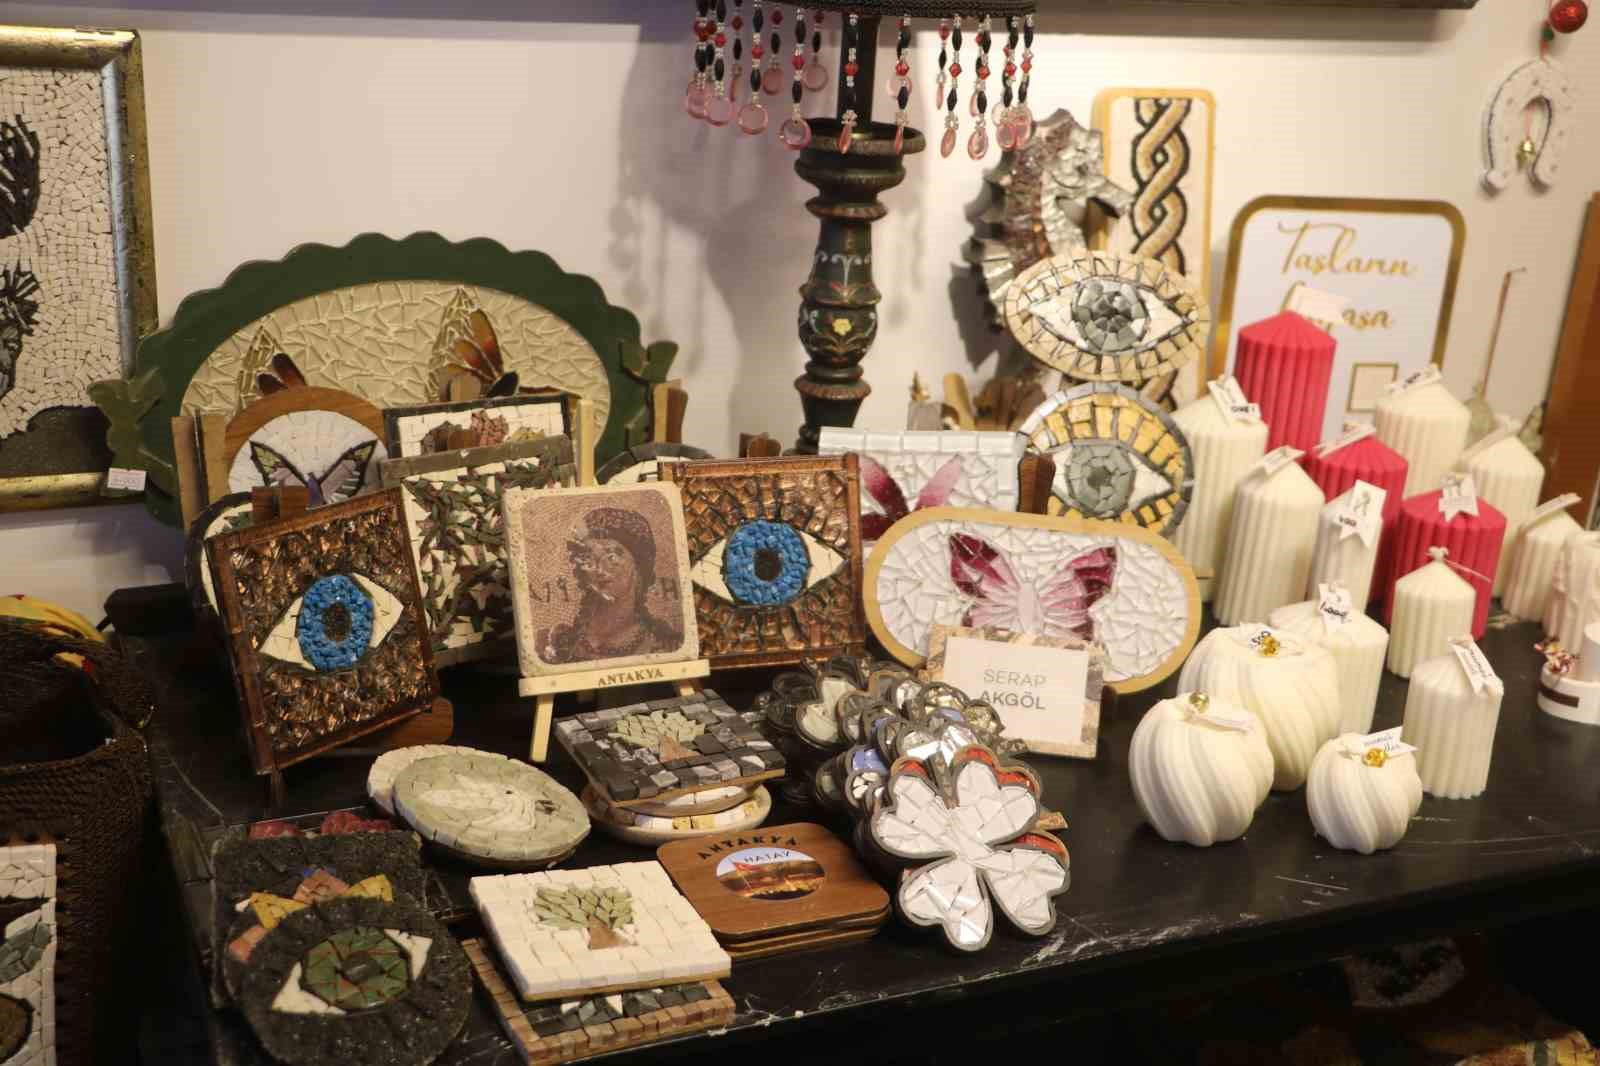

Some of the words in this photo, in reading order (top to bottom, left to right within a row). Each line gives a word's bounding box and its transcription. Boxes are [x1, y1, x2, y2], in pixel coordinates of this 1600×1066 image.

[598, 667, 664, 686] ANTAKYA
[983, 668, 1047, 688] SERAP
[980, 690, 1047, 710] AKGÖL
[697, 835, 797, 860] ANTAKYA
